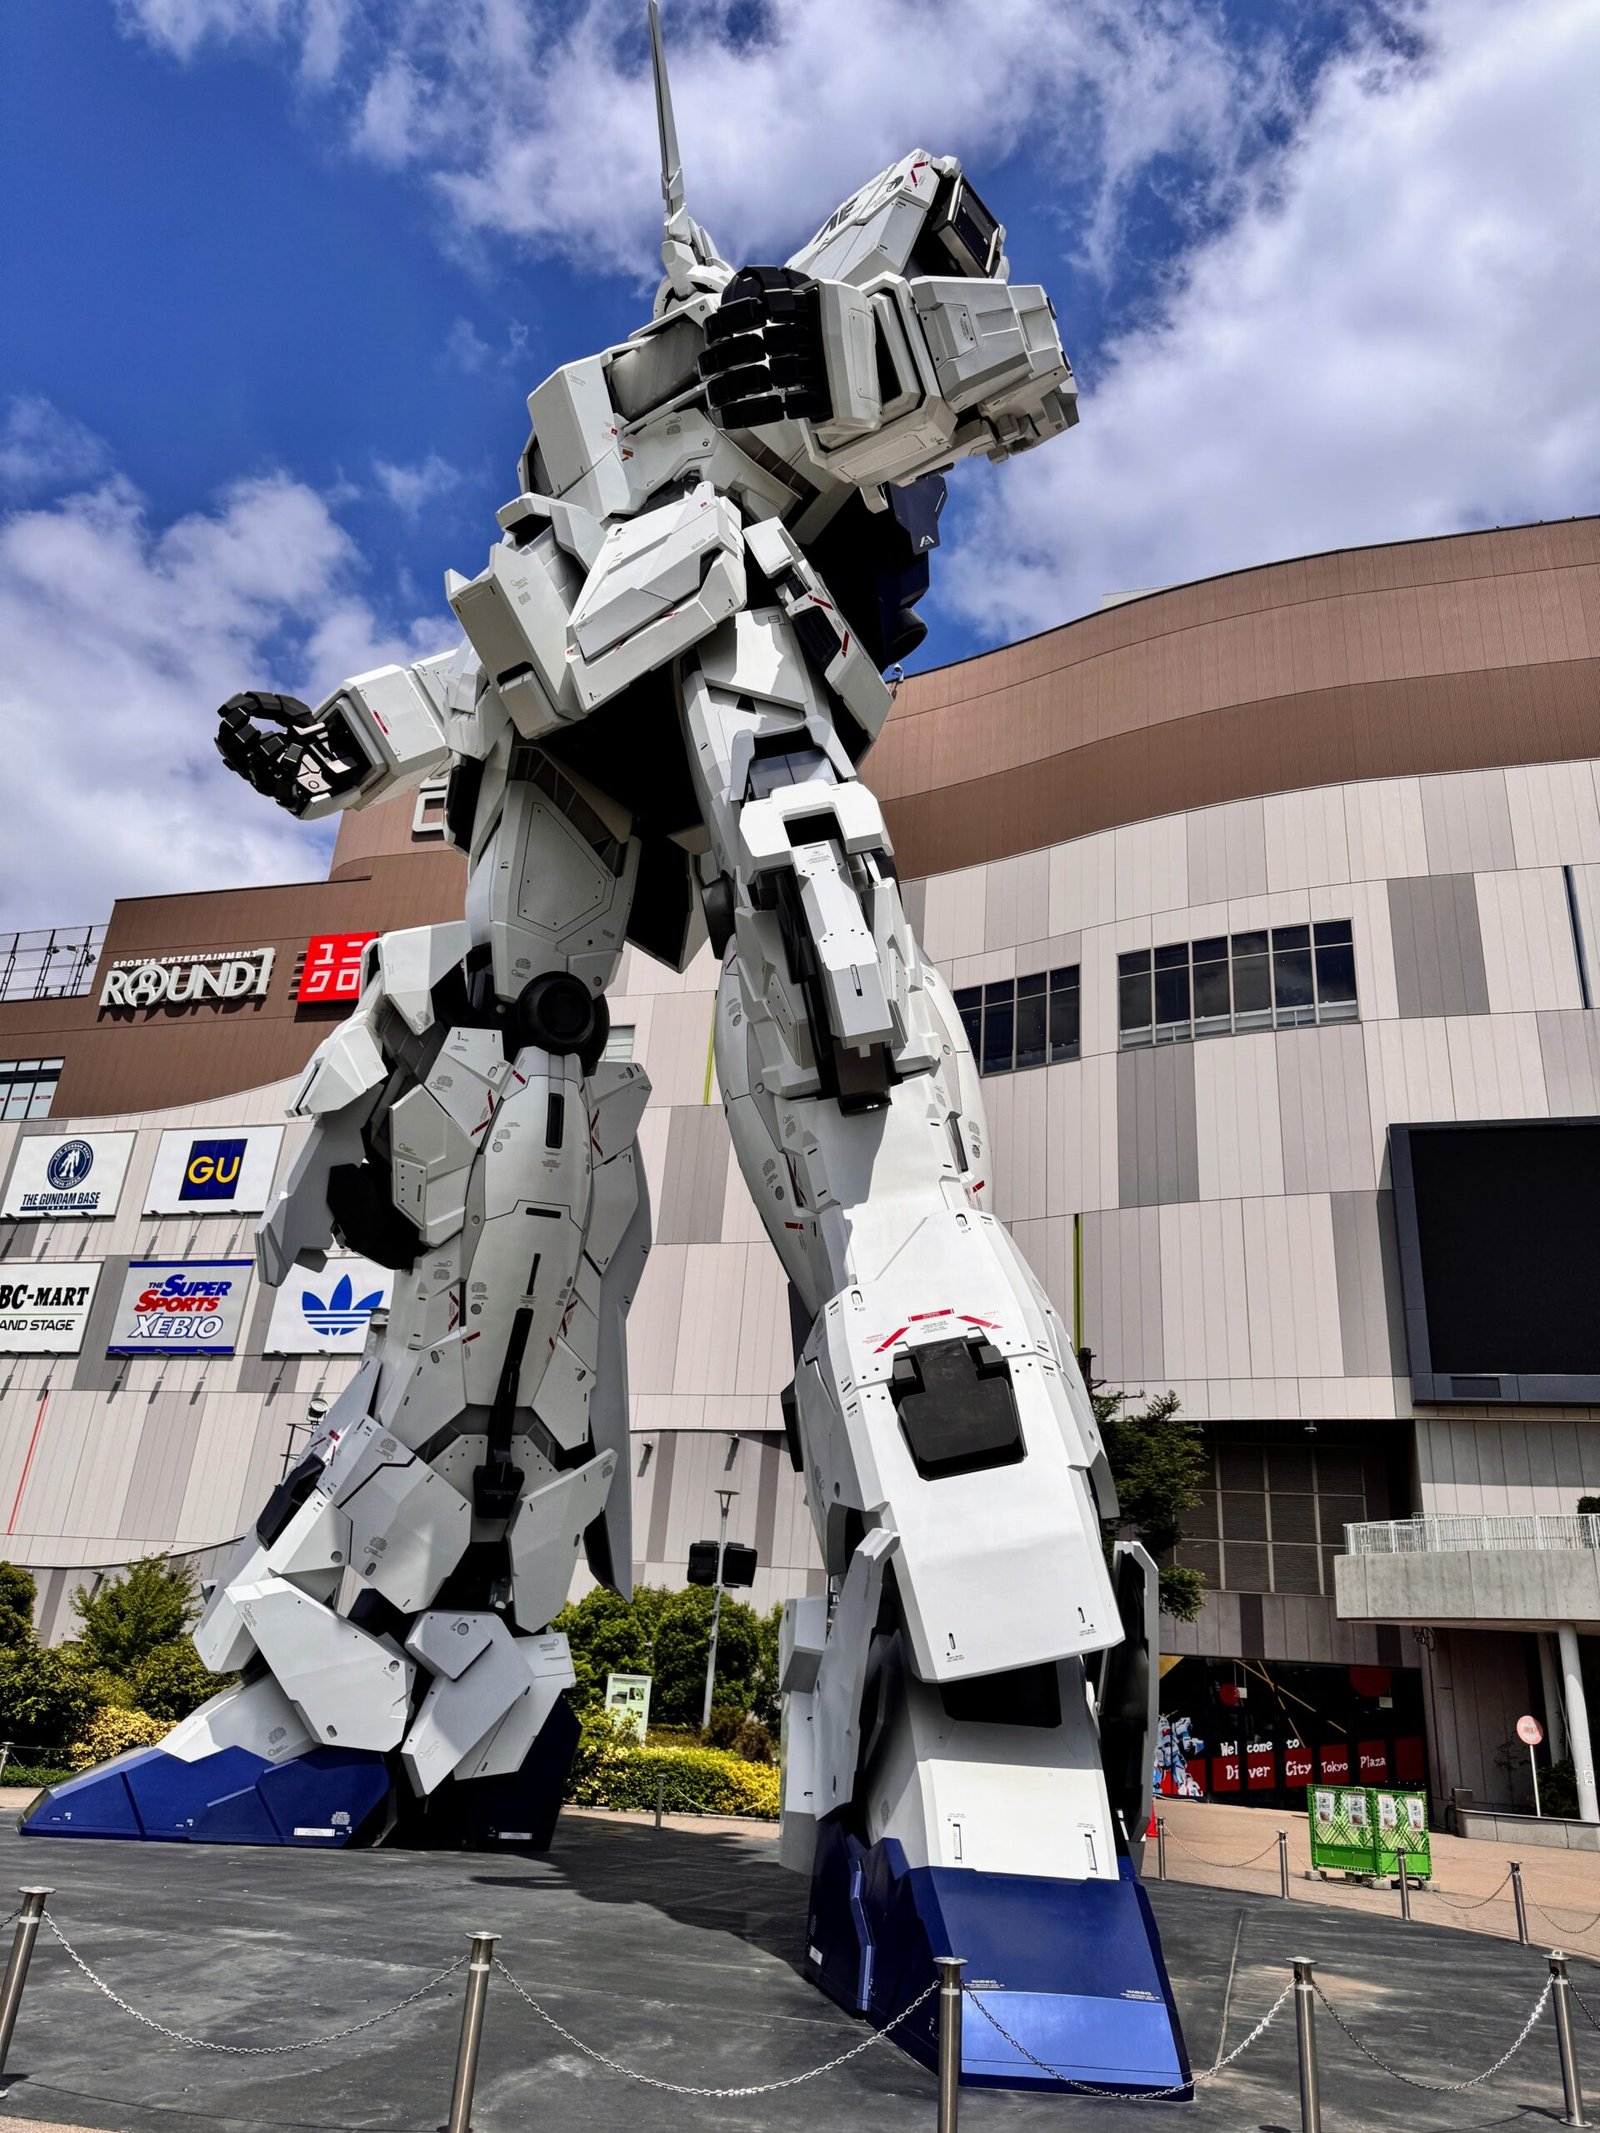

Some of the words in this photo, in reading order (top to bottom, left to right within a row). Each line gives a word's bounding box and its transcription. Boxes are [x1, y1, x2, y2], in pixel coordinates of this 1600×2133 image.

[112, 957, 156, 969] SPORTS
[160, 949, 259, 965] ENTERTAINMENT
[98, 947, 276, 1008] ROUND1
[305, 968, 361, 994] クロ
[187, 1155, 240, 1185] GU
[22, 1193, 39, 1206] THE
[39, 1193, 78, 1206] GUNDAM
[77, 1191, 101, 1204] BASE
[160, 1273, 233, 1297] SUPER
[133, 1289, 221, 1313] SPORTS
[29, 1319, 75, 1331] STAGE
[127, 1312, 224, 1339] XEBIO
[1286, 1738, 1300, 1749] to
[1285, 1760, 1312, 1776] City
[1321, 1761, 1348, 1773] Tokyo
[1360, 1756, 1386, 1768] Plaza
